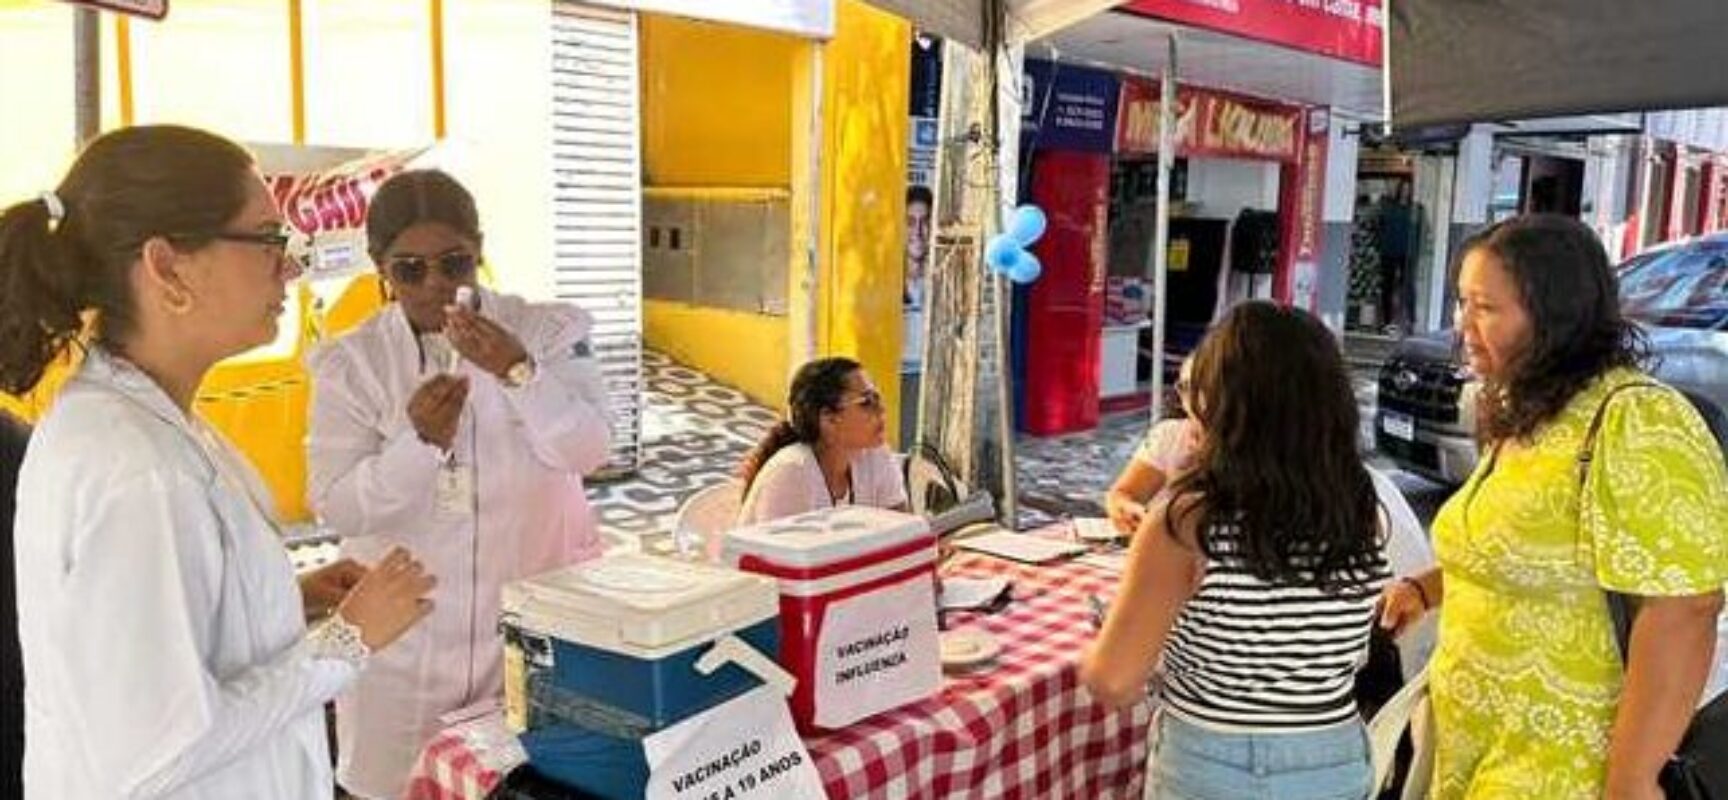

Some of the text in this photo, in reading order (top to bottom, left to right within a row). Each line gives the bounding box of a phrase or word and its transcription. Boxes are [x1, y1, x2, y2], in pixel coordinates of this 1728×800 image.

[837, 625, 909, 658] VACINAÇÃO
[836, 652, 906, 684] INFLUENZA
[673, 740, 762, 793] VACINAÇÃO
[723, 785, 735, 800] A
[738, 773, 756, 793] 19
[760, 751, 802, 782] ANOS
